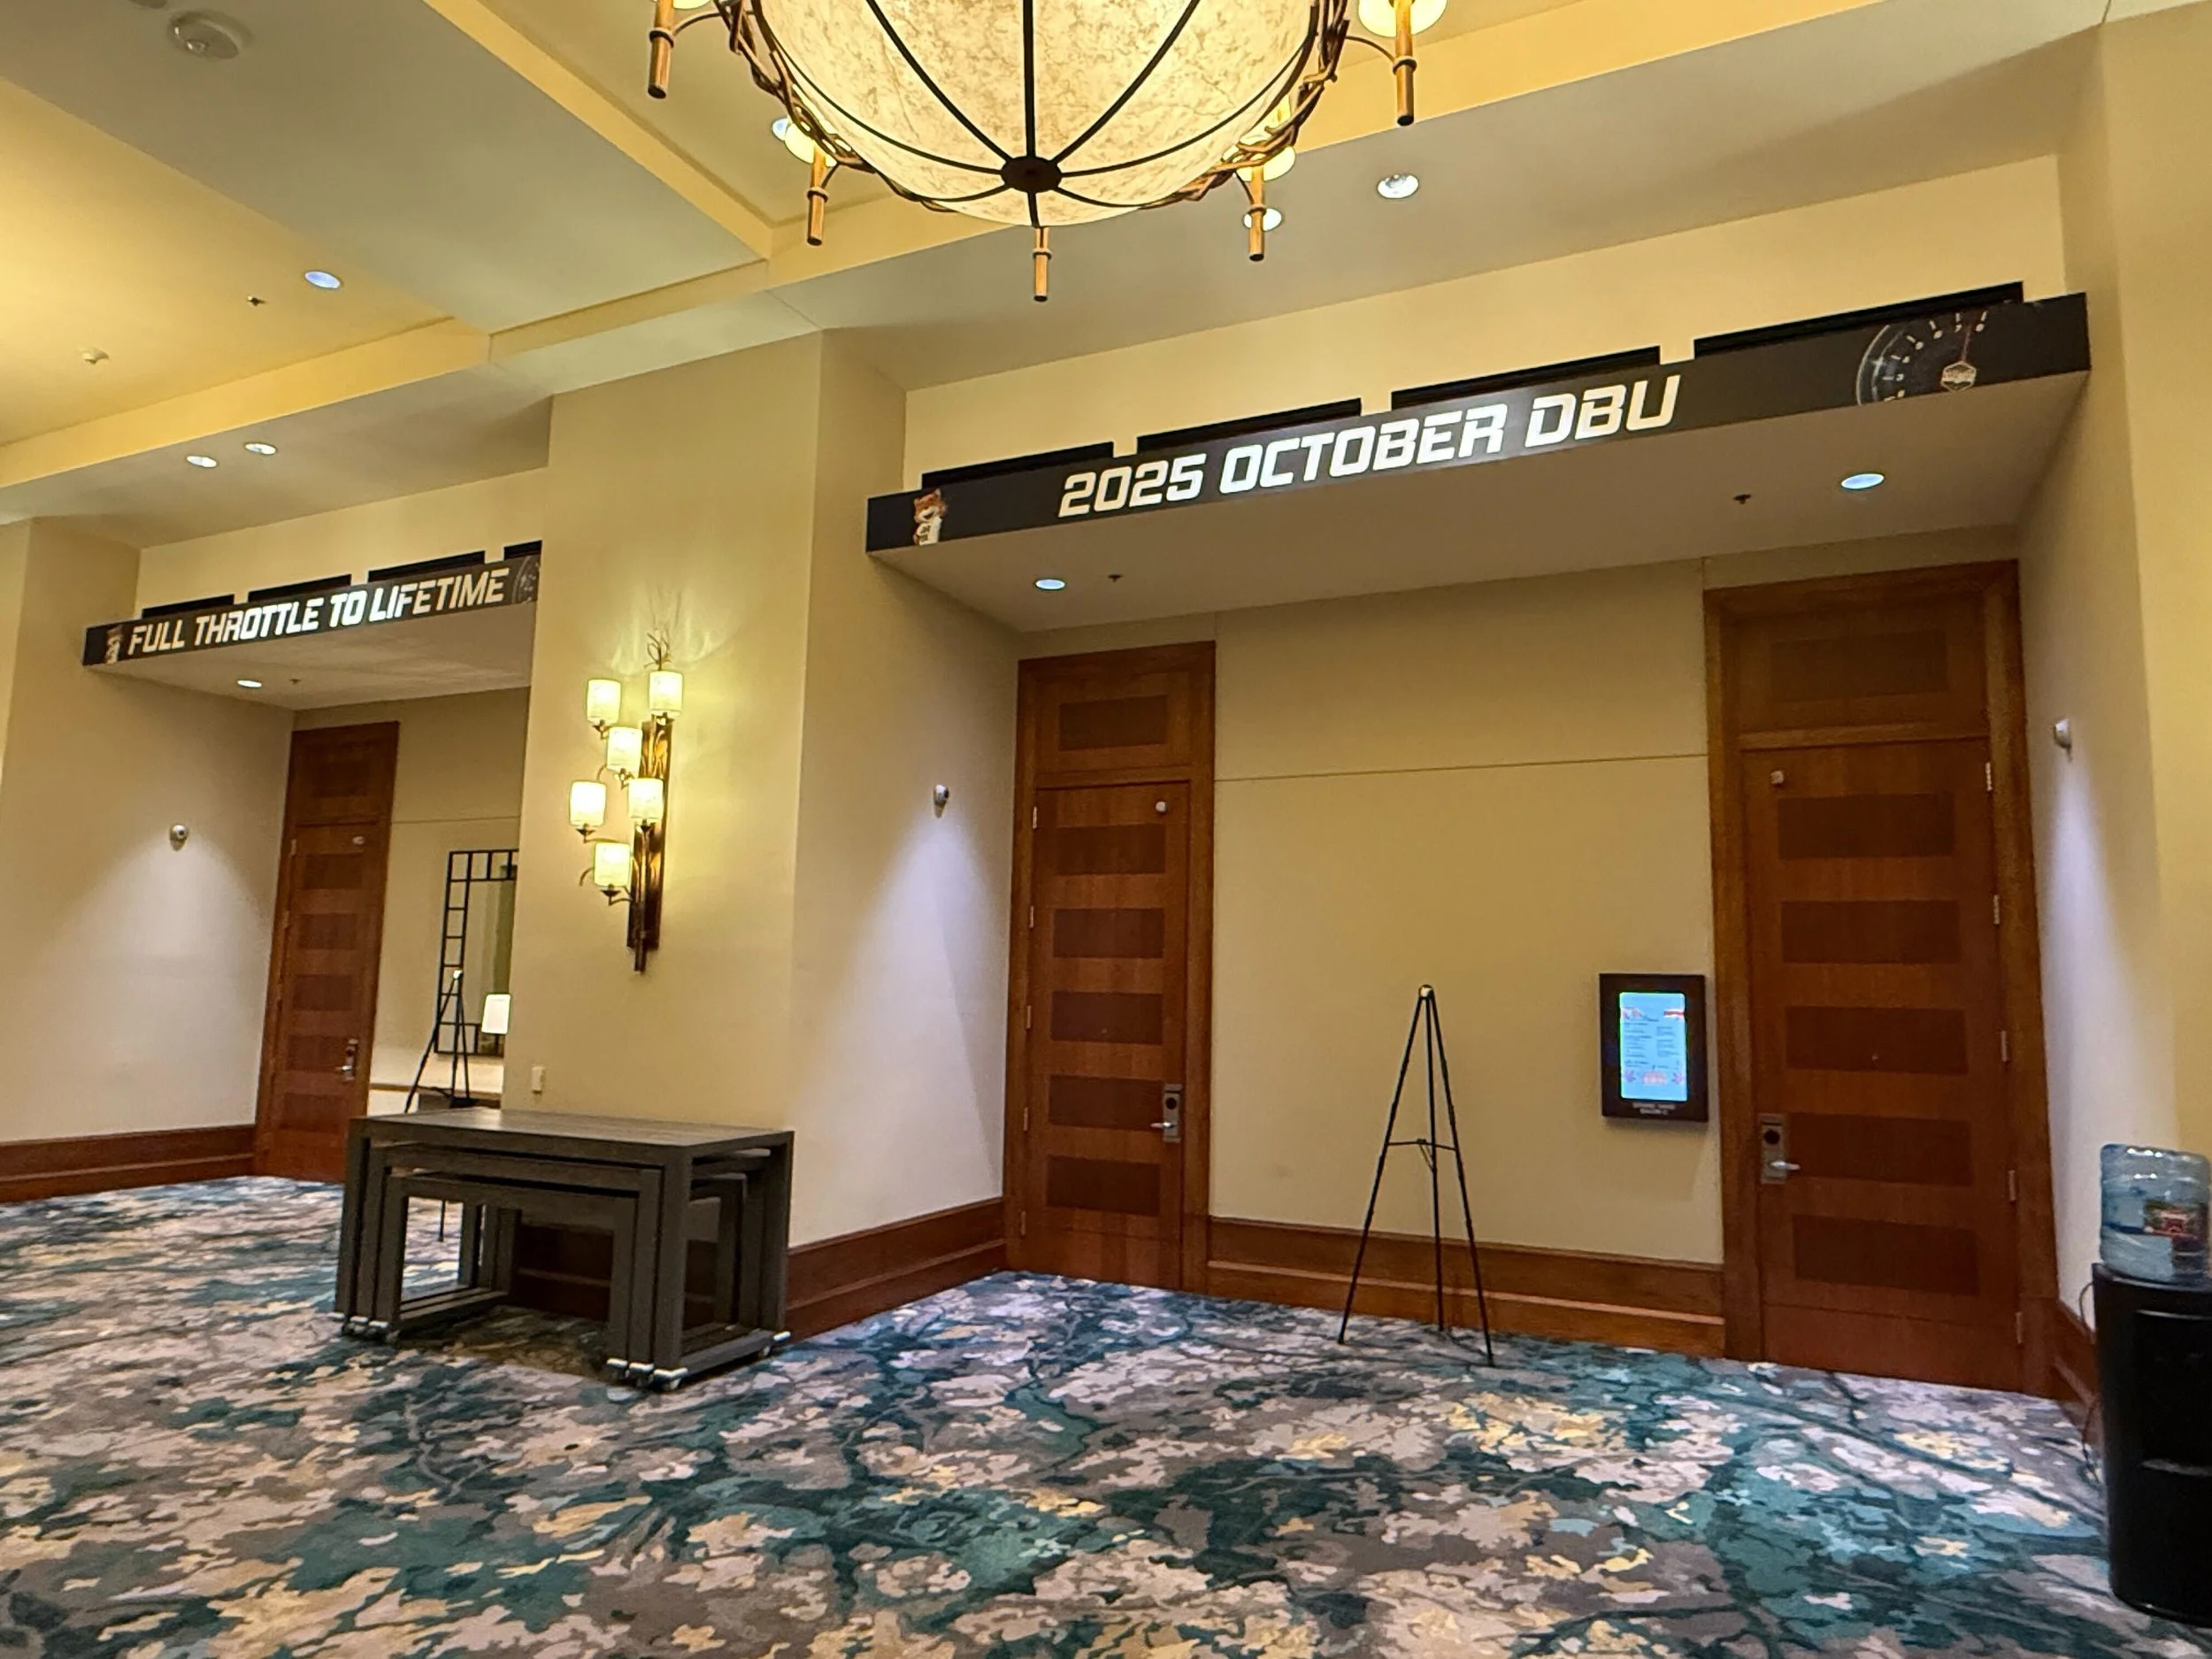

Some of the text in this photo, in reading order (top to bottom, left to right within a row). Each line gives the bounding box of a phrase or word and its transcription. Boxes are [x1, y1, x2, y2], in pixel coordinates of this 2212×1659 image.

[1058, 375, 1680, 518] 2025 OCTOBER DBU
[128, 567, 511, 655] FULL THROTTLE TO LIFETIME
